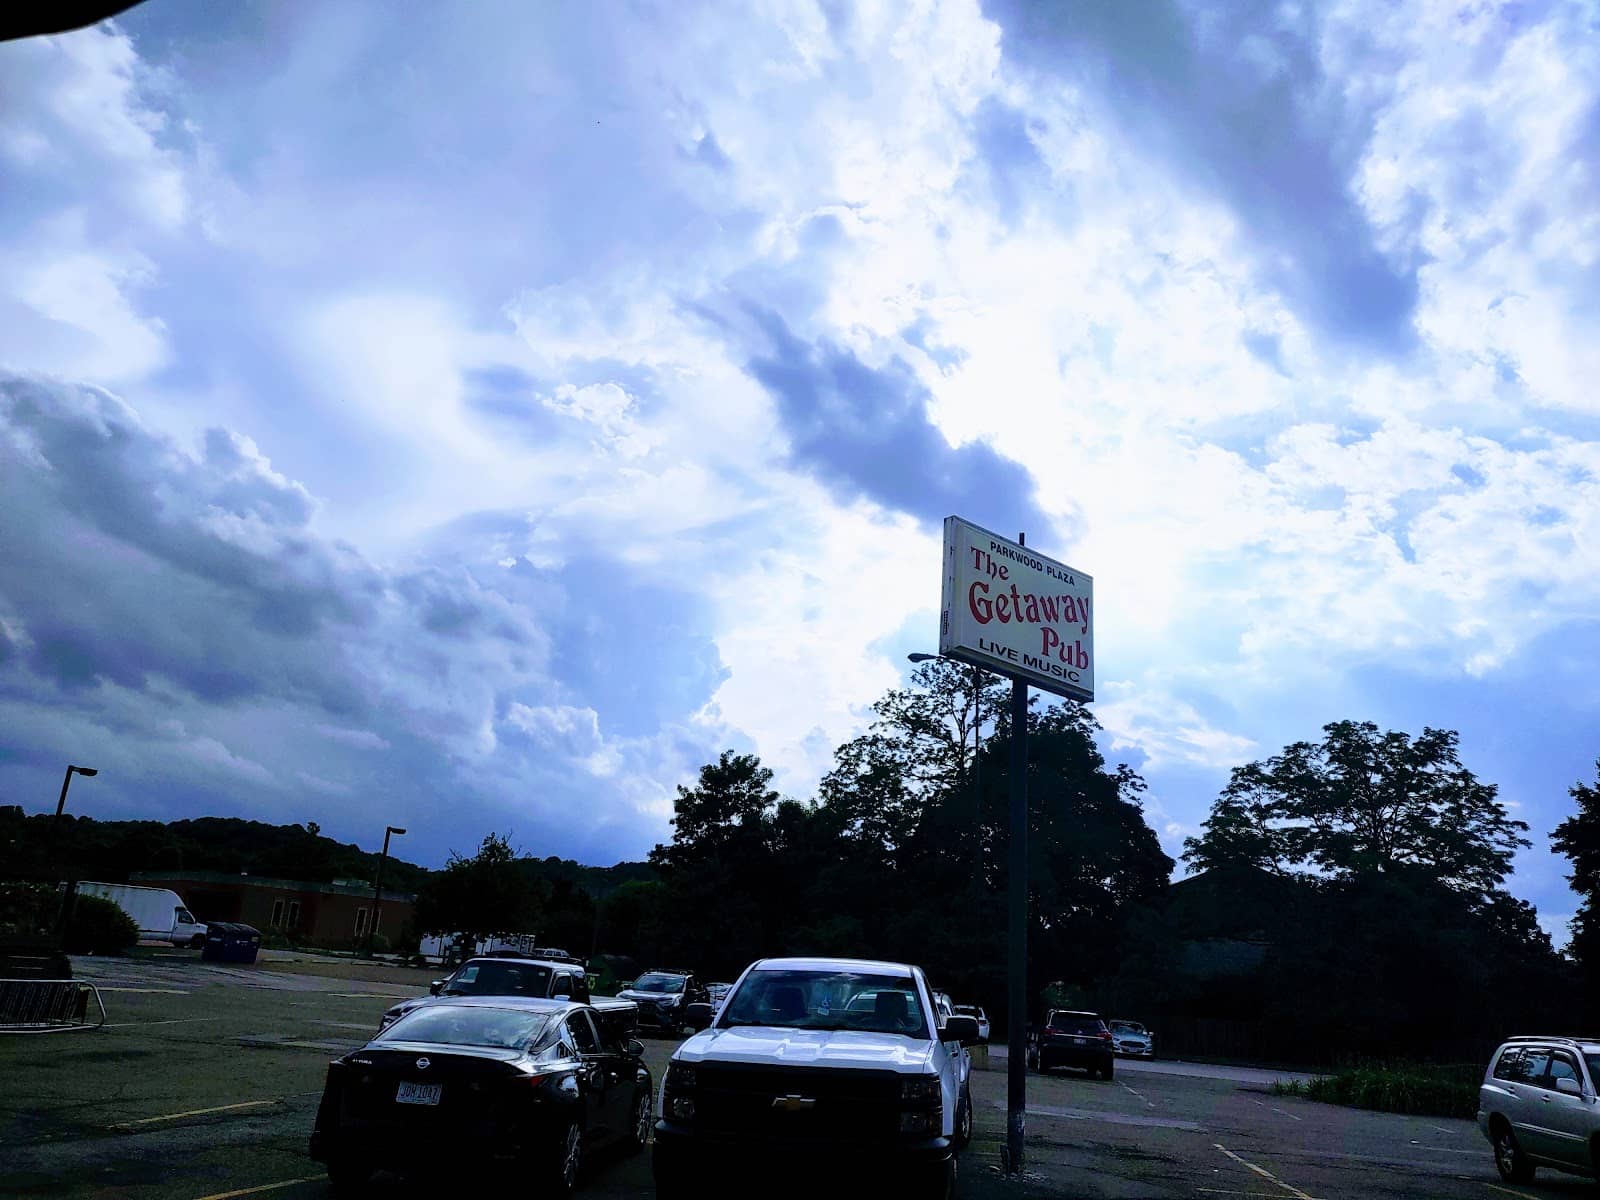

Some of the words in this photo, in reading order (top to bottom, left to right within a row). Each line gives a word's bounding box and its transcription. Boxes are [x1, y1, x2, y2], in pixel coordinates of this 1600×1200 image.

[970, 546, 1010, 580] The
[990, 541, 1043, 571] PARKWOOD
[1047, 565, 1075, 586] PLAZA
[968, 581, 1089, 634] Getaway
[979, 638, 1018, 662] LIVE
[1023, 654, 1080, 683] MUSIC
[1040, 626, 1089, 670] Pub
